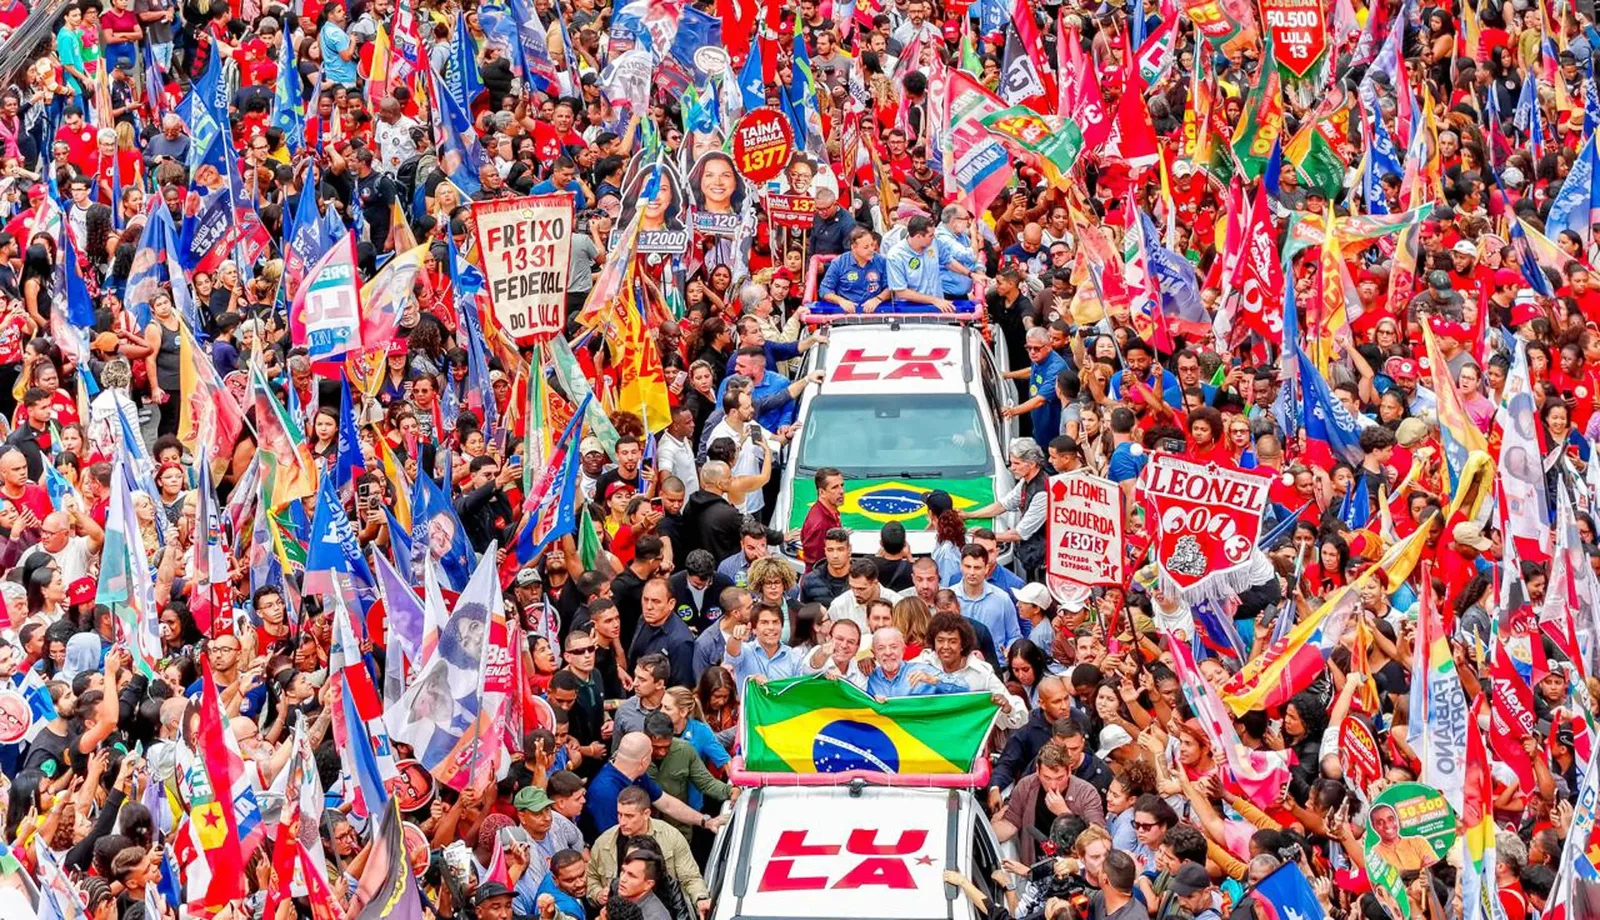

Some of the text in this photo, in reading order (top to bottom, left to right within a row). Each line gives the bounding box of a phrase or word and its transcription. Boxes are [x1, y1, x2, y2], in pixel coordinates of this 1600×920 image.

[1266, 11, 1318, 27] 50.500
[1280, 32, 1312, 44] LULA
[1289, 45, 1308, 59] 13
[740, 117, 781, 140] TAINÁ
[756, 132, 785, 145] PAULA
[742, 144, 788, 174] 1377
[714, 214, 737, 227] 120
[487, 217, 565, 252] FREIXO
[648, 232, 685, 245] 12000
[502, 244, 555, 275] 1331
[493, 271, 564, 304] FEDERAL
[509, 303, 560, 331] DO LULA
[1070, 479, 1111, 506] LEONEL
[1148, 465, 1262, 512] LEONEL
[1054, 506, 1116, 538] ESQUERDA
[1066, 530, 1105, 555] 13013
[1494, 679, 1526, 717] Alex
